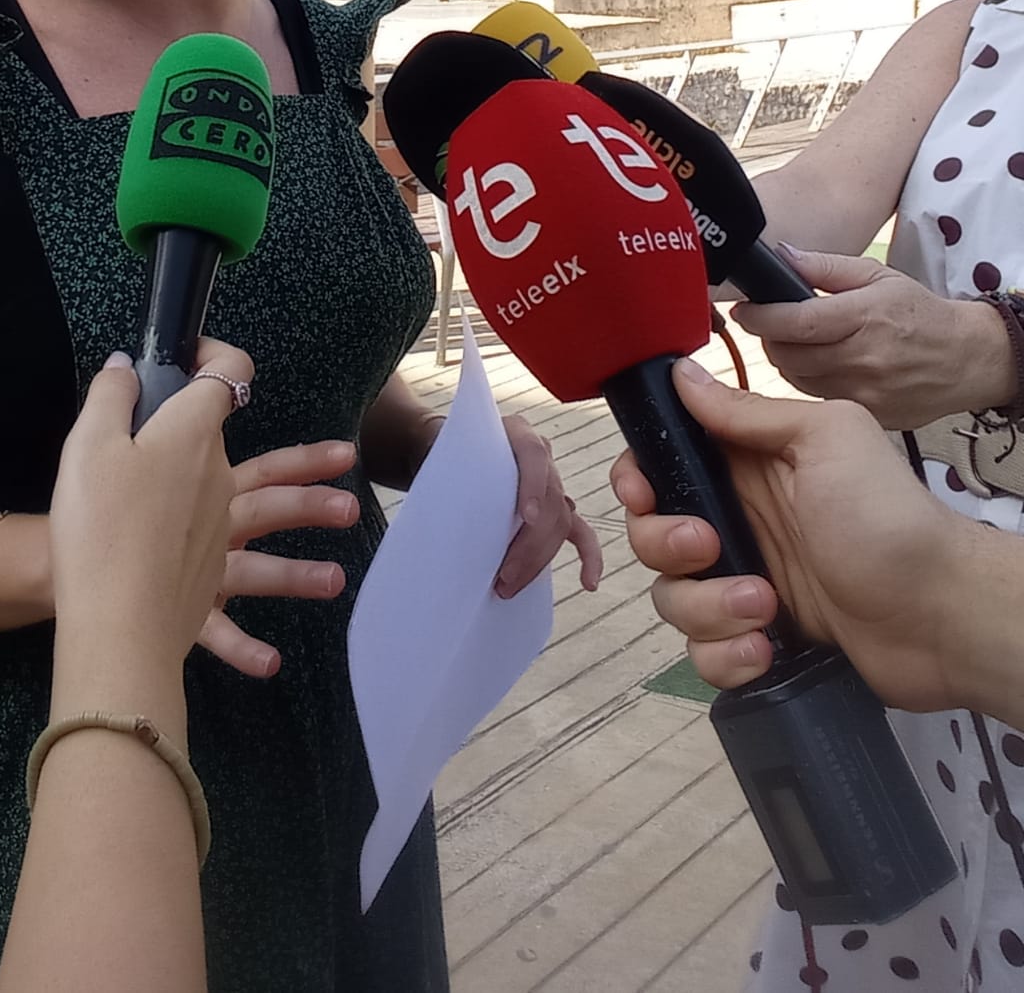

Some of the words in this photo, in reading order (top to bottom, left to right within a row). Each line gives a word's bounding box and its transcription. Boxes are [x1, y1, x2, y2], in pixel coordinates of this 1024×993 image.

[180, 87, 269, 128] ONDA
[179, 119, 267, 161] CERO
[618, 225, 697, 256] teleelx
[495, 254, 587, 327] teleelx
